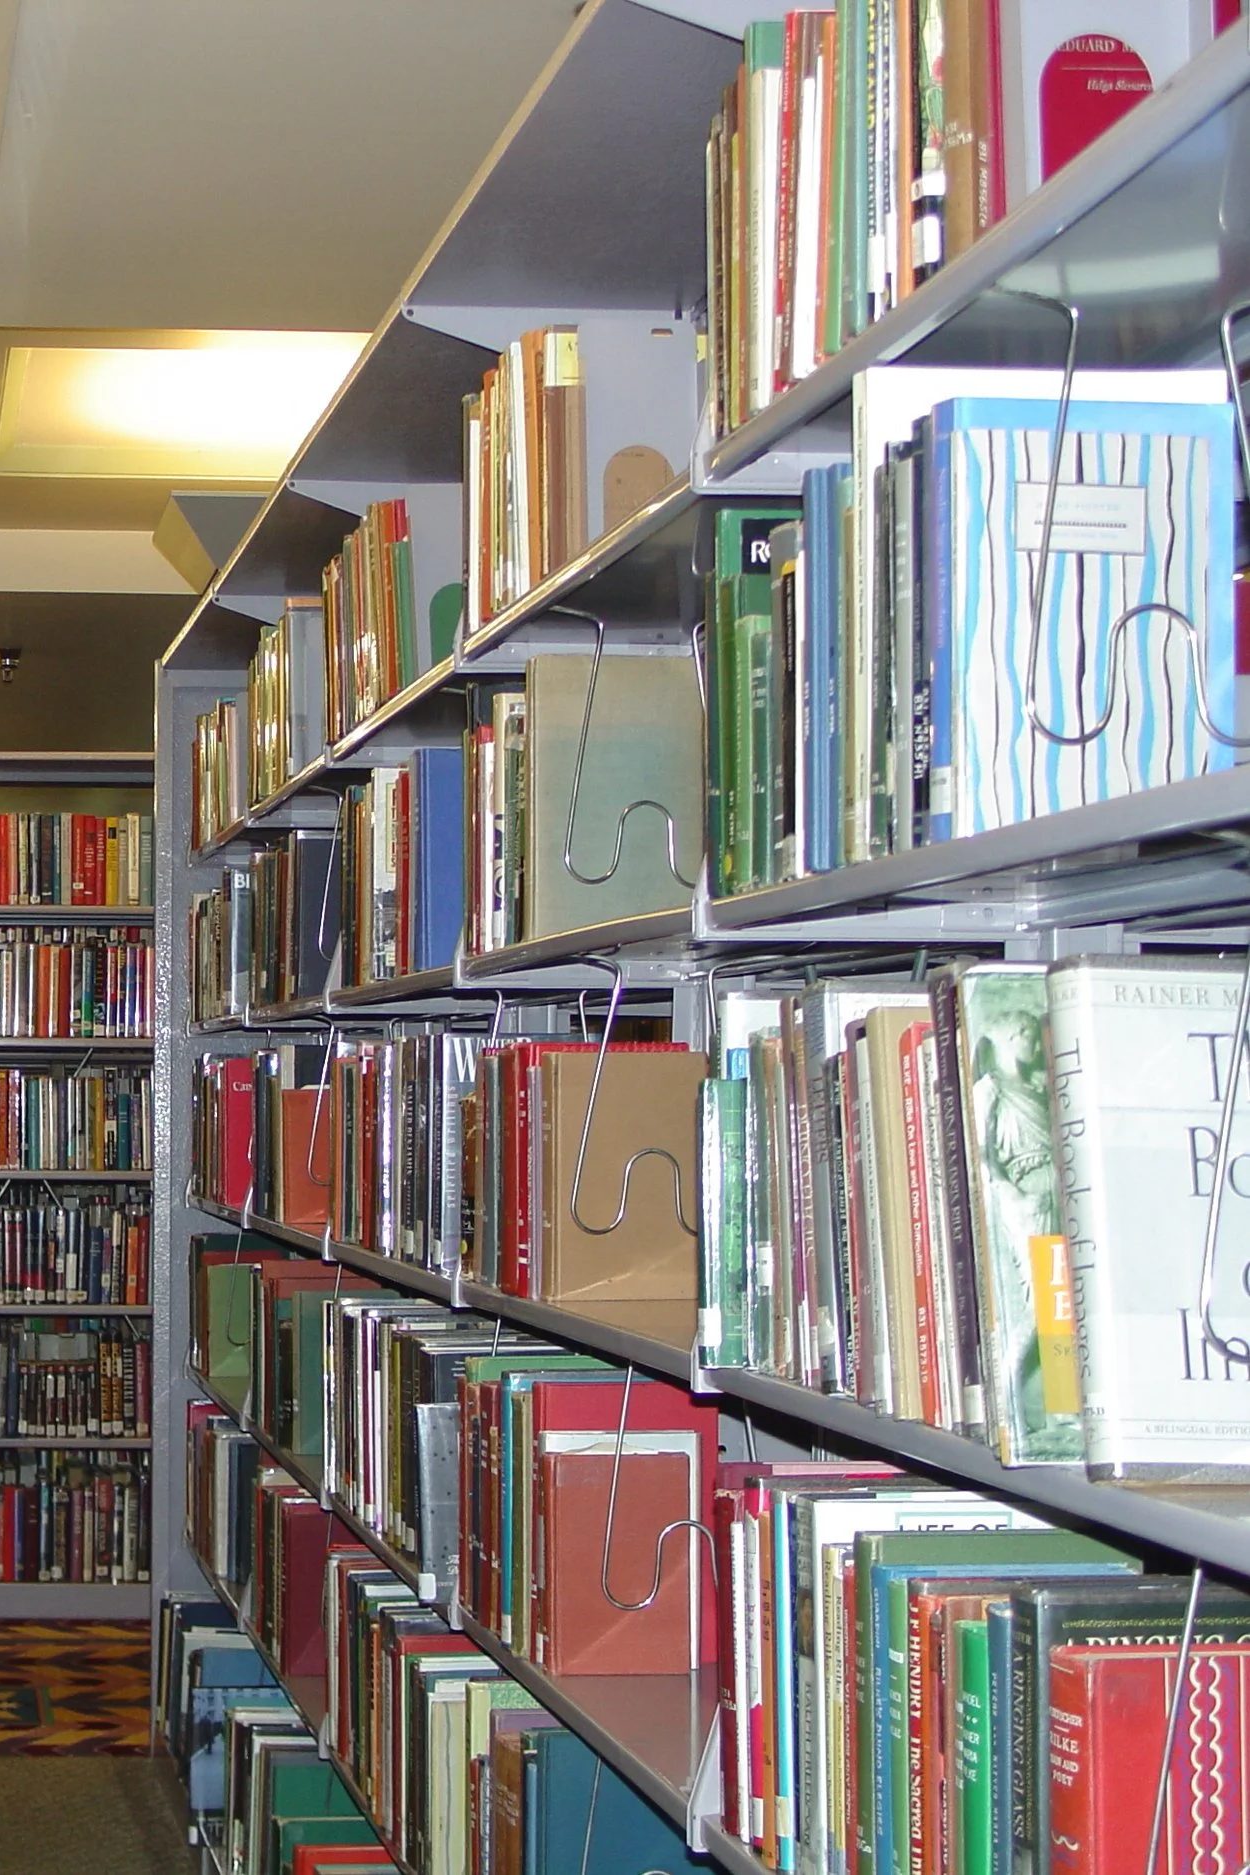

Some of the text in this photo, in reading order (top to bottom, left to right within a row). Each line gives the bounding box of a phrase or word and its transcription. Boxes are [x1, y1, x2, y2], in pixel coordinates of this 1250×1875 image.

[1114, 985, 1210, 1006] RAINER
[1054, 1037, 1083, 1110] The
[944, 1095, 958, 1152] RAINER
[447, 1152, 456, 1209] selected
[907, 1141, 917, 1167] Love
[910, 1168, 919, 1188] and
[947, 1153, 961, 1204] MARIA
[1059, 1118, 1092, 1208] Book
[911, 1190, 921, 1220] Other
[913, 1222, 923, 1277] Difficulties
[1066, 1217, 1097, 1259] of
[917, 1307, 926, 1328] 831
[1071, 1262, 1095, 1382] Images
[1155, 1425, 1210, 1435] BILINGUAL
[1214, 1425, 1250, 1435] EDITIO
[835, 1595, 843, 1653] Reading
[909, 1634, 921, 1719] HENDRY
[1013, 1669, 1024, 1765] RINGING
[910, 1736, 921, 1771] The
[910, 1773, 922, 1840] Sacred
[1013, 1769, 1024, 1839] GLASS
